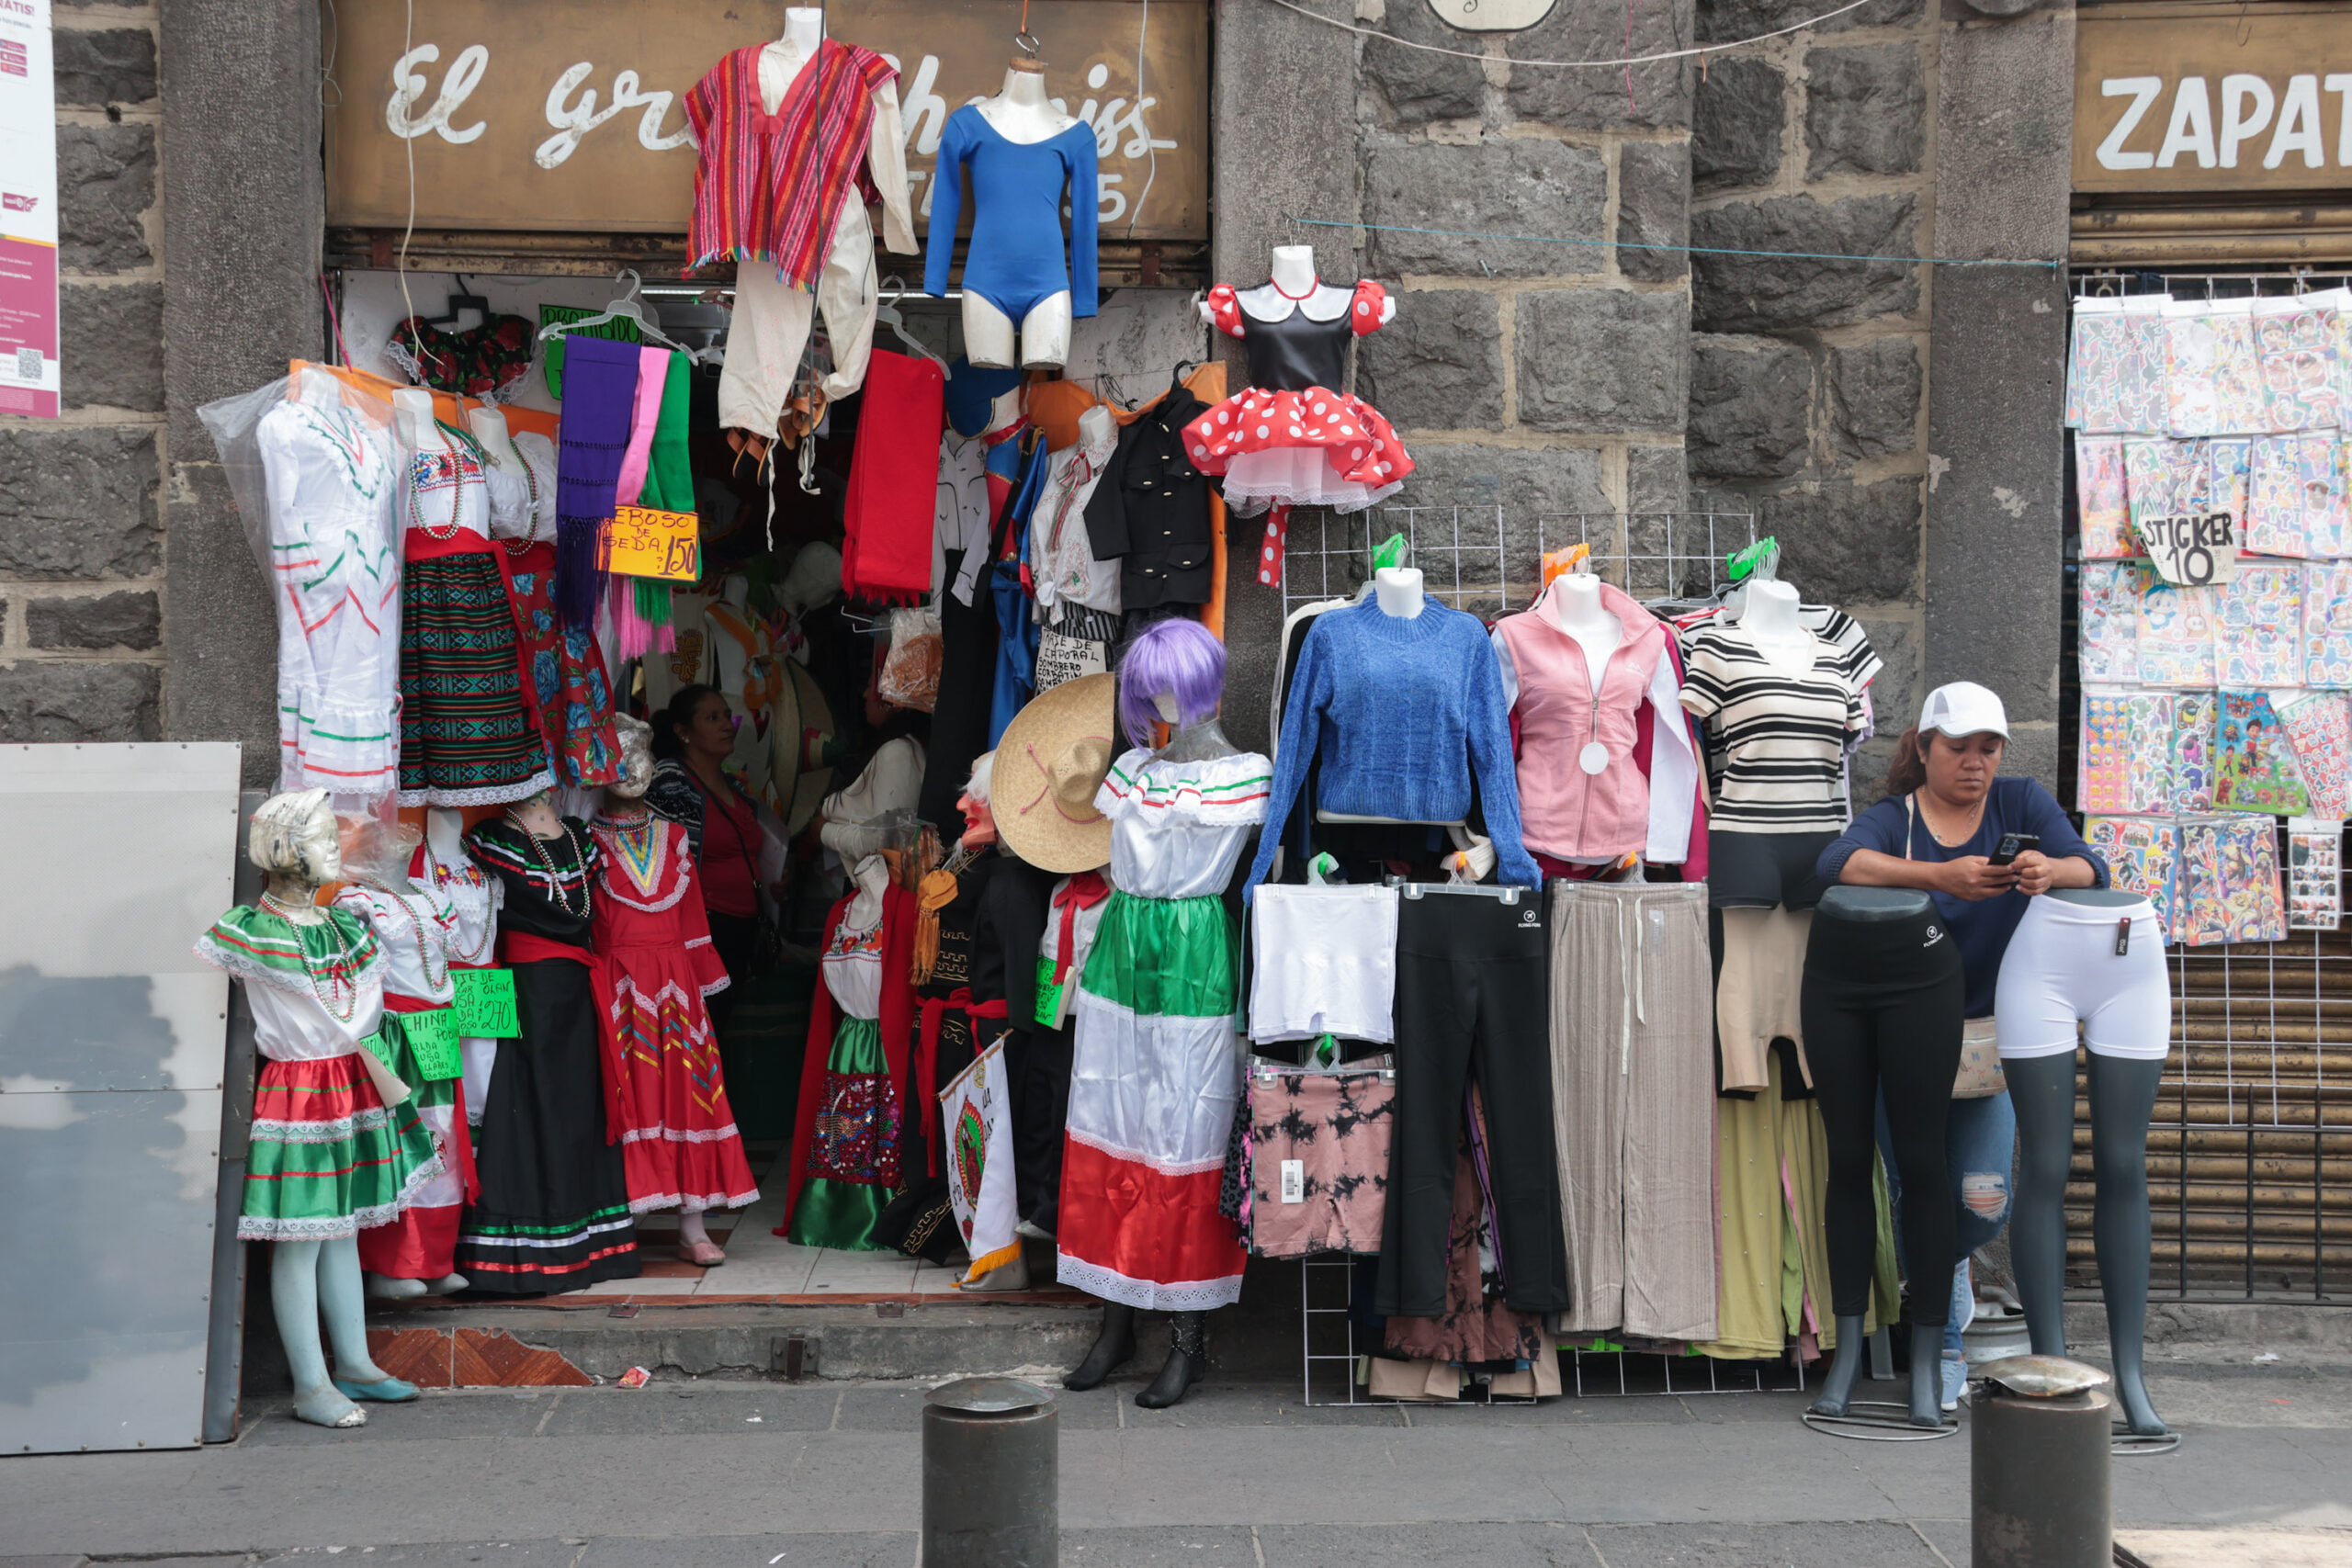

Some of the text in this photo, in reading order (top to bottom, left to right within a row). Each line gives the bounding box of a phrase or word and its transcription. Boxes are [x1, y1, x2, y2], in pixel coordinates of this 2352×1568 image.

[386, 43, 489, 144] El
[615, 508, 690, 528] EBOSO
[631, 526, 650, 539] DE
[603, 535, 695, 576] SEDA 150
[2165, 545, 2214, 587] 10
[1043, 628, 1093, 652] TRAJE DE
[1038, 656, 1081, 671] SOMBRERO
[1045, 648, 1100, 662] CAPORAL
[481, 971, 494, 985] DE
[402, 1011, 447, 1032] CHINA
[481, 999, 511, 1032] 270
